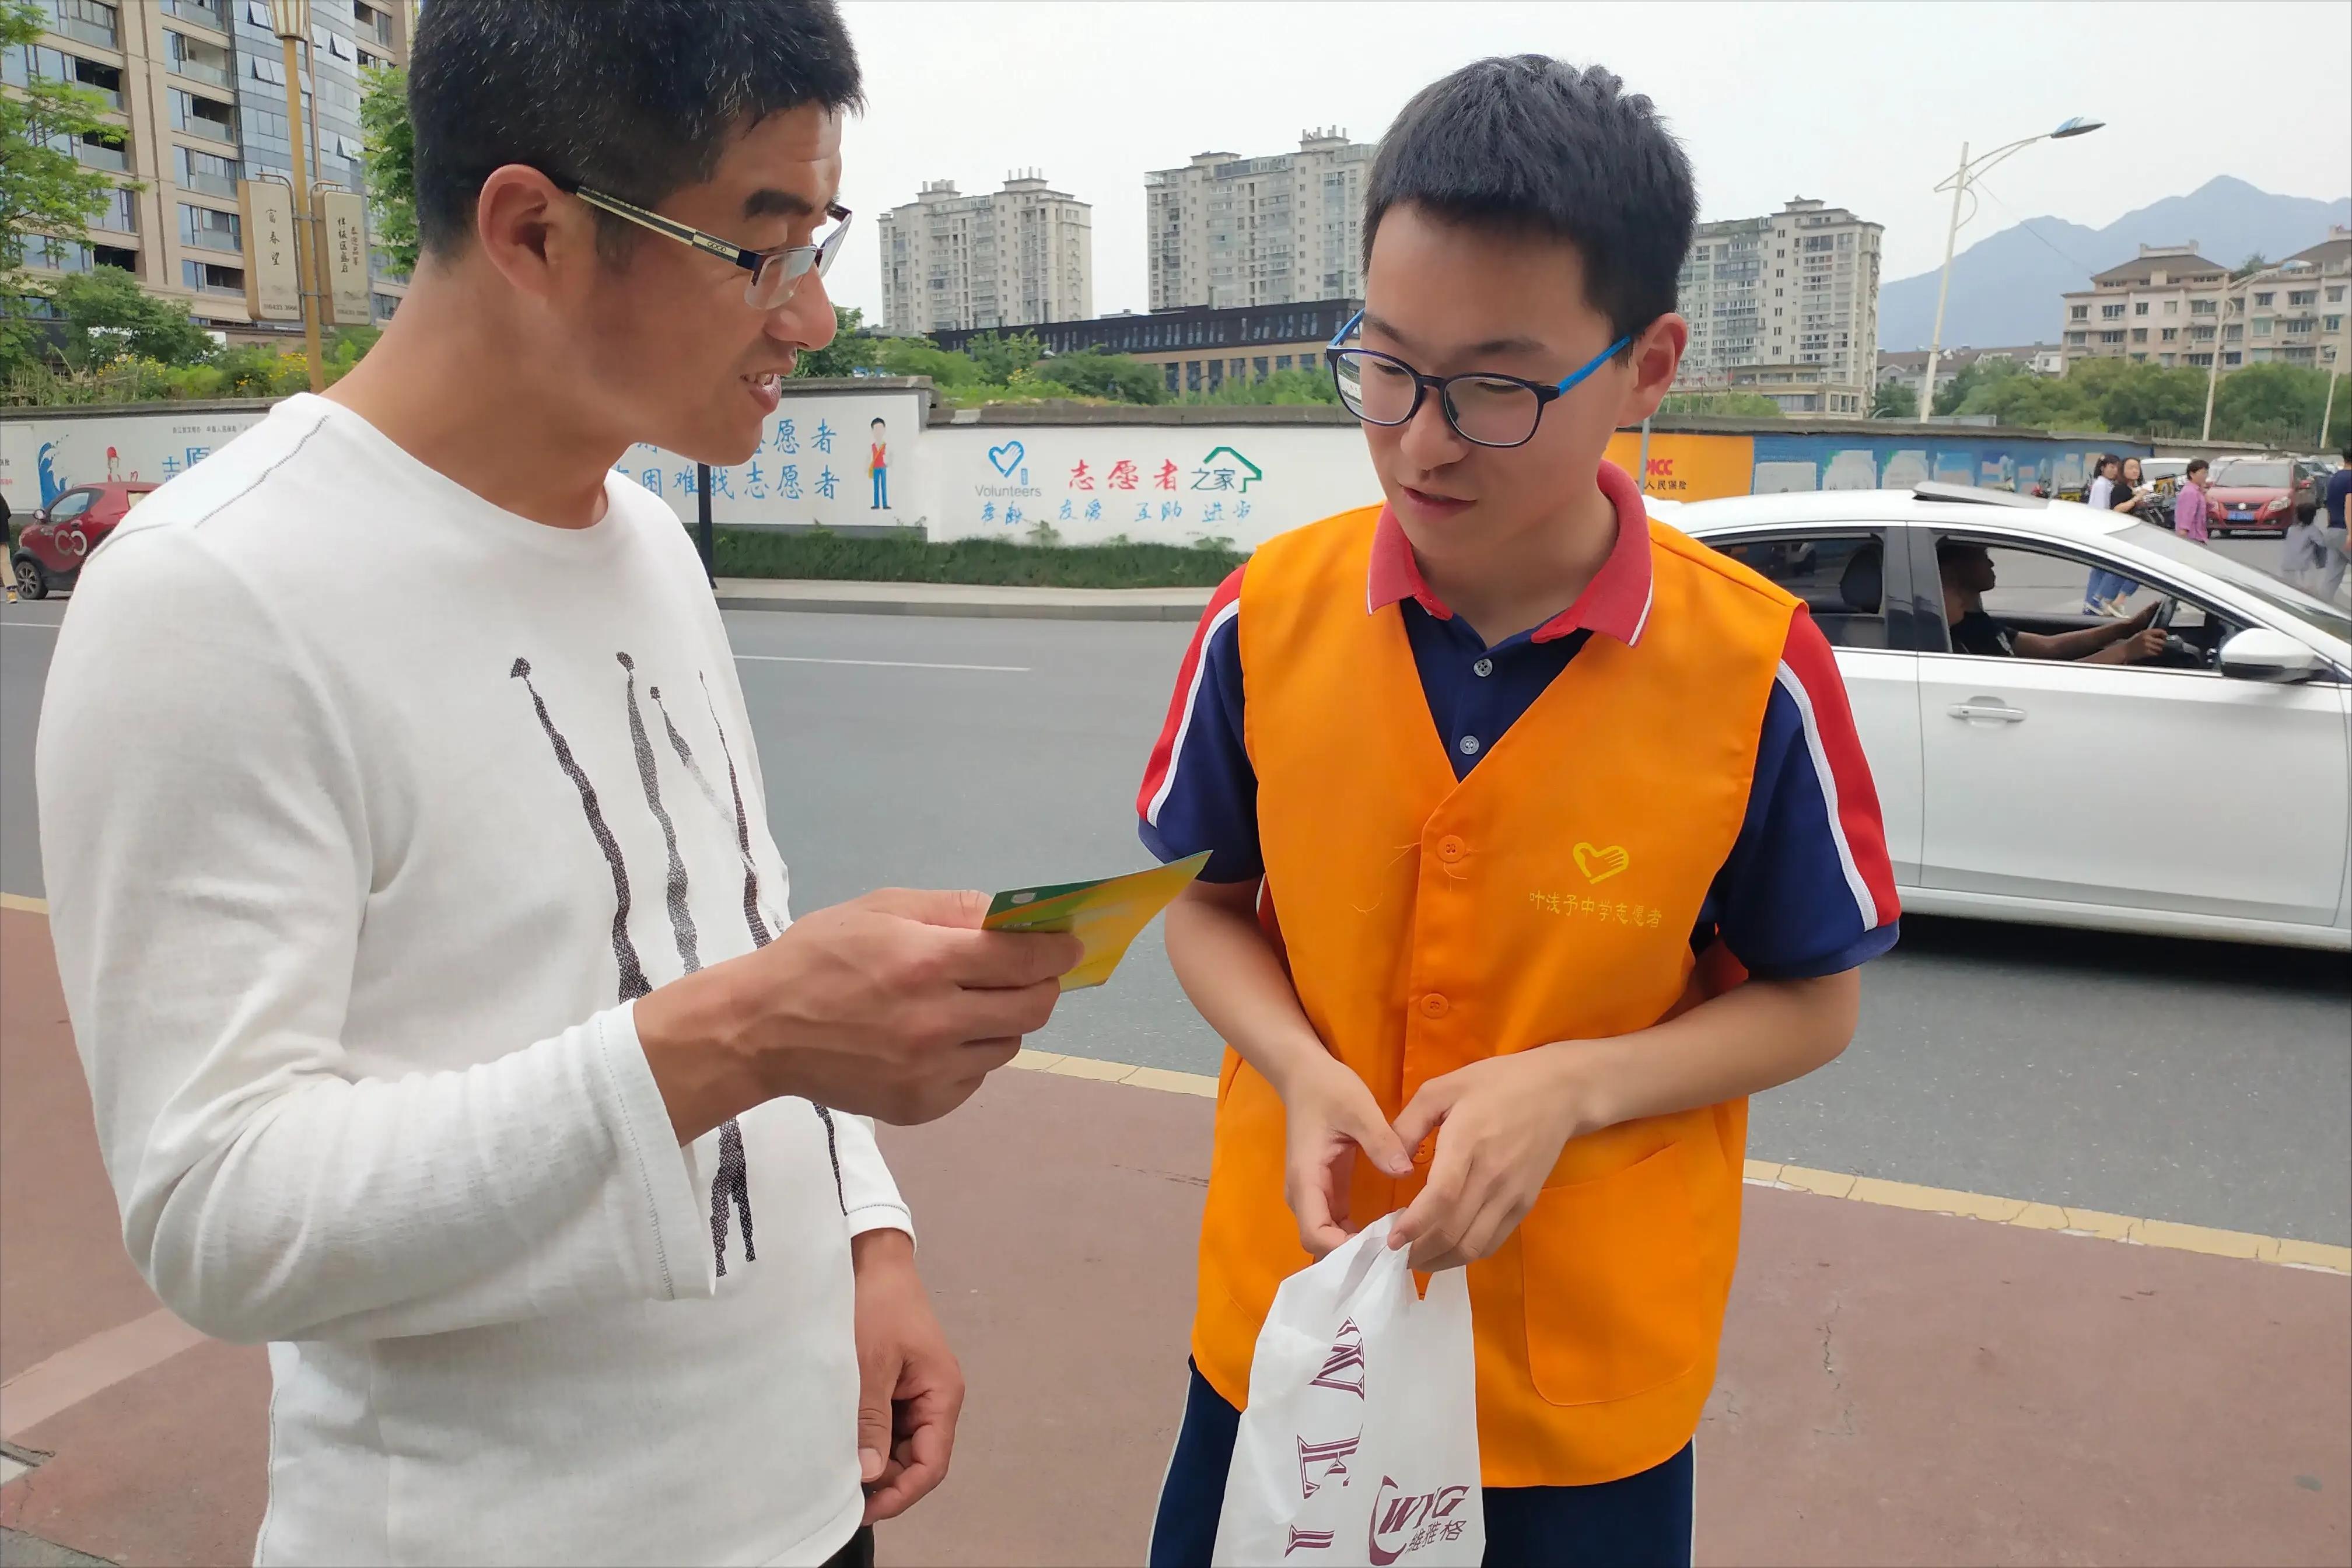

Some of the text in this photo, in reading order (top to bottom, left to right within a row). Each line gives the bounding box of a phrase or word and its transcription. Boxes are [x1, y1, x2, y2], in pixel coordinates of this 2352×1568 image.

[266, 208, 280, 265] 富春望
[615, 461, 840, 500] 困难找志愿者
[975, 485, 1041, 497] Volunteers
[1530, 890, 1661, 928] 叶浅予中学志愿者
